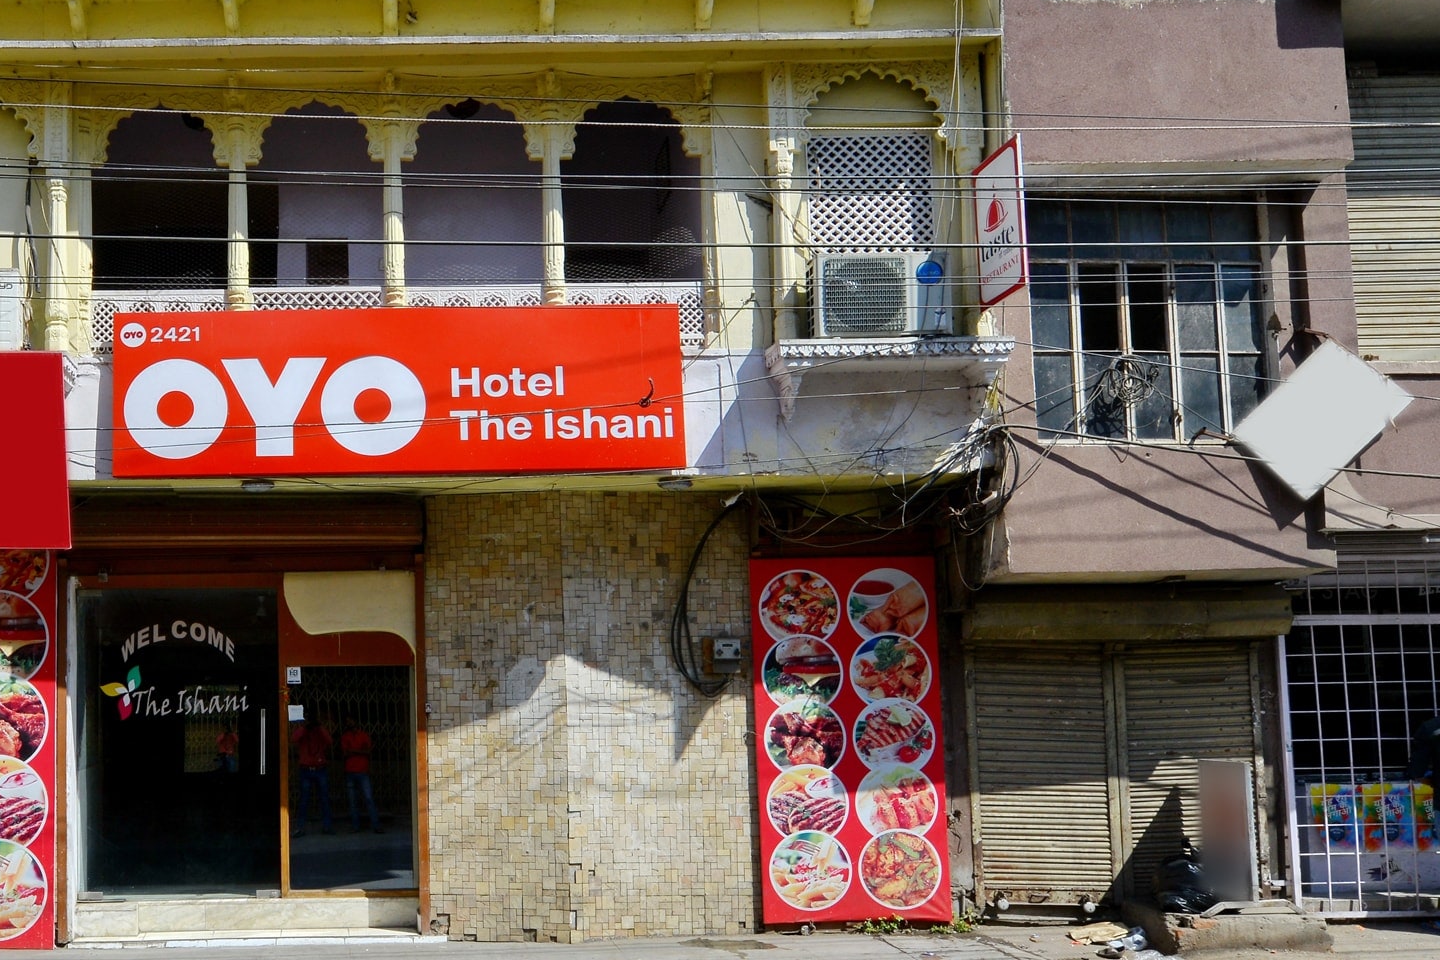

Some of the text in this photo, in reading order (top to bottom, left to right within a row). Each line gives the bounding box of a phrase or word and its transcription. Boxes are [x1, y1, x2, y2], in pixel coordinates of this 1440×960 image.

[982, 254, 1020, 285] RESTAURANT
[123, 326, 200, 342] OYO 2421
[450, 365, 565, 398] Hotel
[123, 355, 427, 460] OYO
[449, 407, 674, 441] The Ishani
[132, 685, 250, 717] The Ishani
